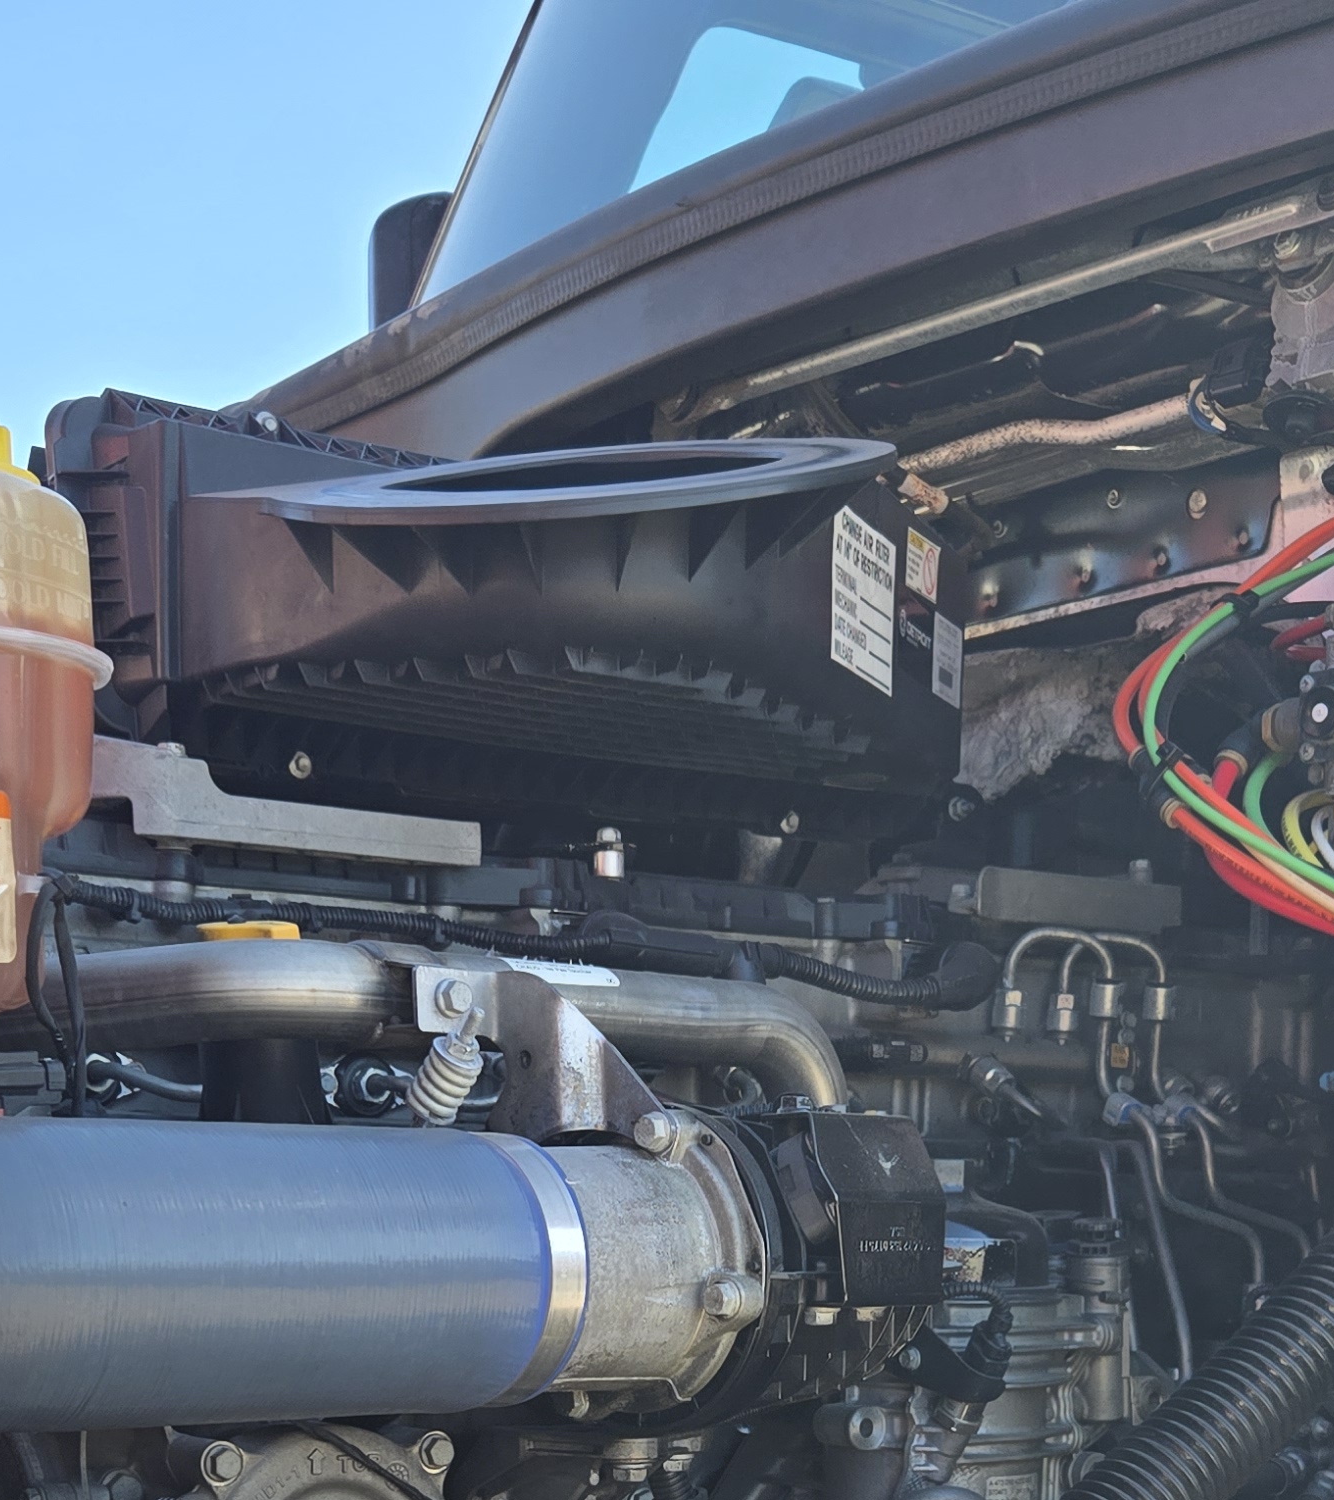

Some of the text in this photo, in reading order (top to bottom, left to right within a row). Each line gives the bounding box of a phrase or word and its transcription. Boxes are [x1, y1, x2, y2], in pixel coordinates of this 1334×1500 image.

[835, 564, 858, 596] TERMINAL
[860, 552, 893, 594] RESTRICTION
[834, 588, 858, 620] MECHANIC
[834, 613, 867, 651] DATE CHANGED
[907, 620, 931, 650] DETROIT
[834, 639, 854, 668] MILEAGE
